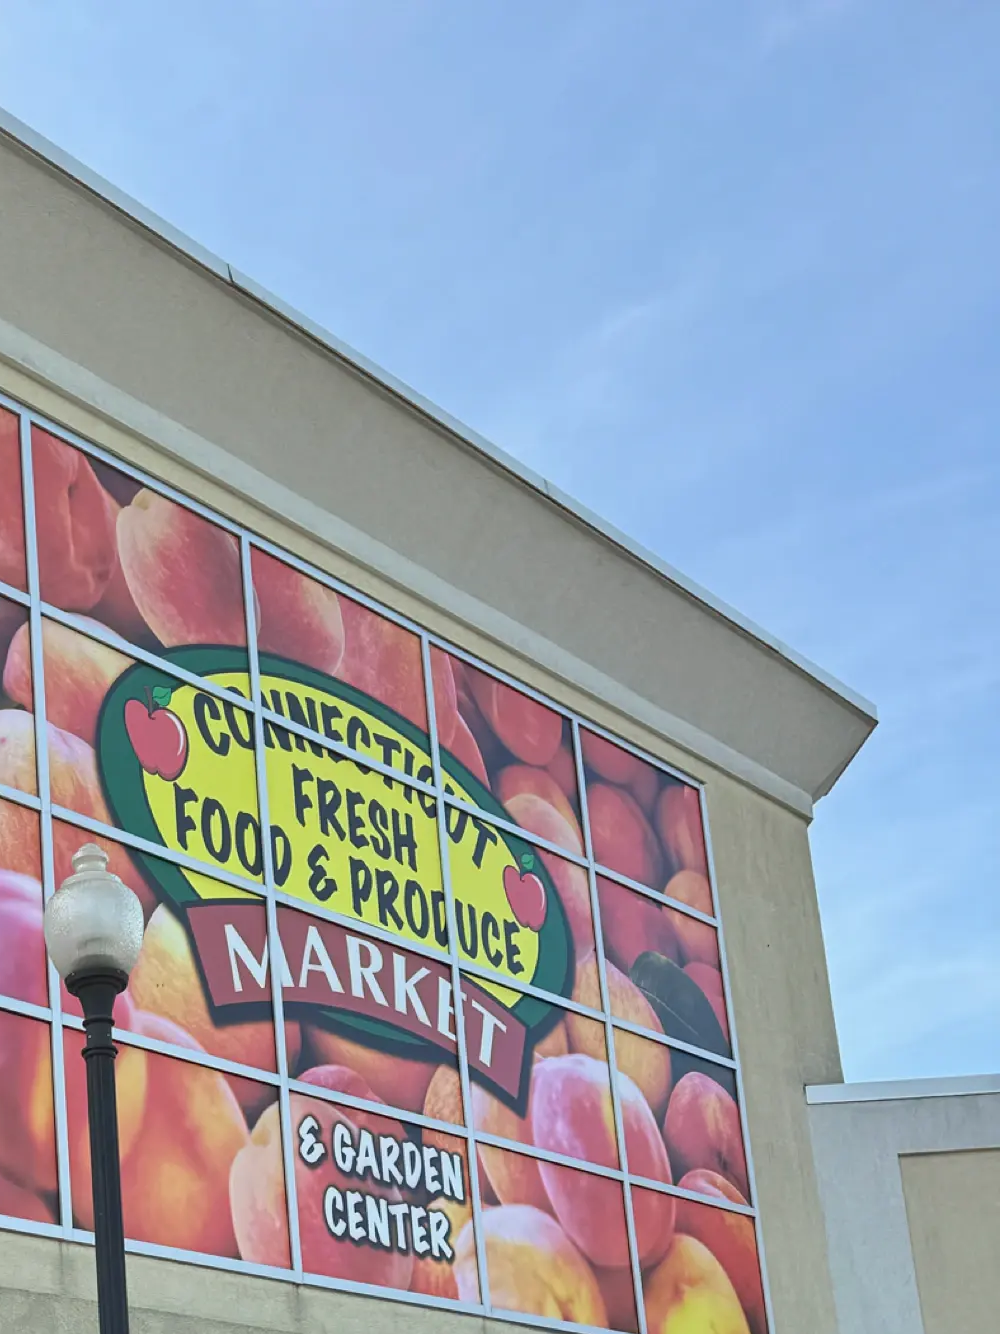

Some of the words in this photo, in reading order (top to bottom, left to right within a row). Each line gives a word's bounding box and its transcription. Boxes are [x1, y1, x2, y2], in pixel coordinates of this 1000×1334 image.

[193, 686, 498, 869] CONNECTICUT
[291, 762, 418, 872] FRESH
[173, 782, 292, 886] FOOD
[307, 843, 338, 901] &
[348, 855, 525, 976] PRODUCE
[224, 923, 507, 1068] MARKET
[298, 1116, 326, 1164] &
[332, 1122, 464, 1201] GARDEN
[323, 1185, 454, 1259] CENTER
